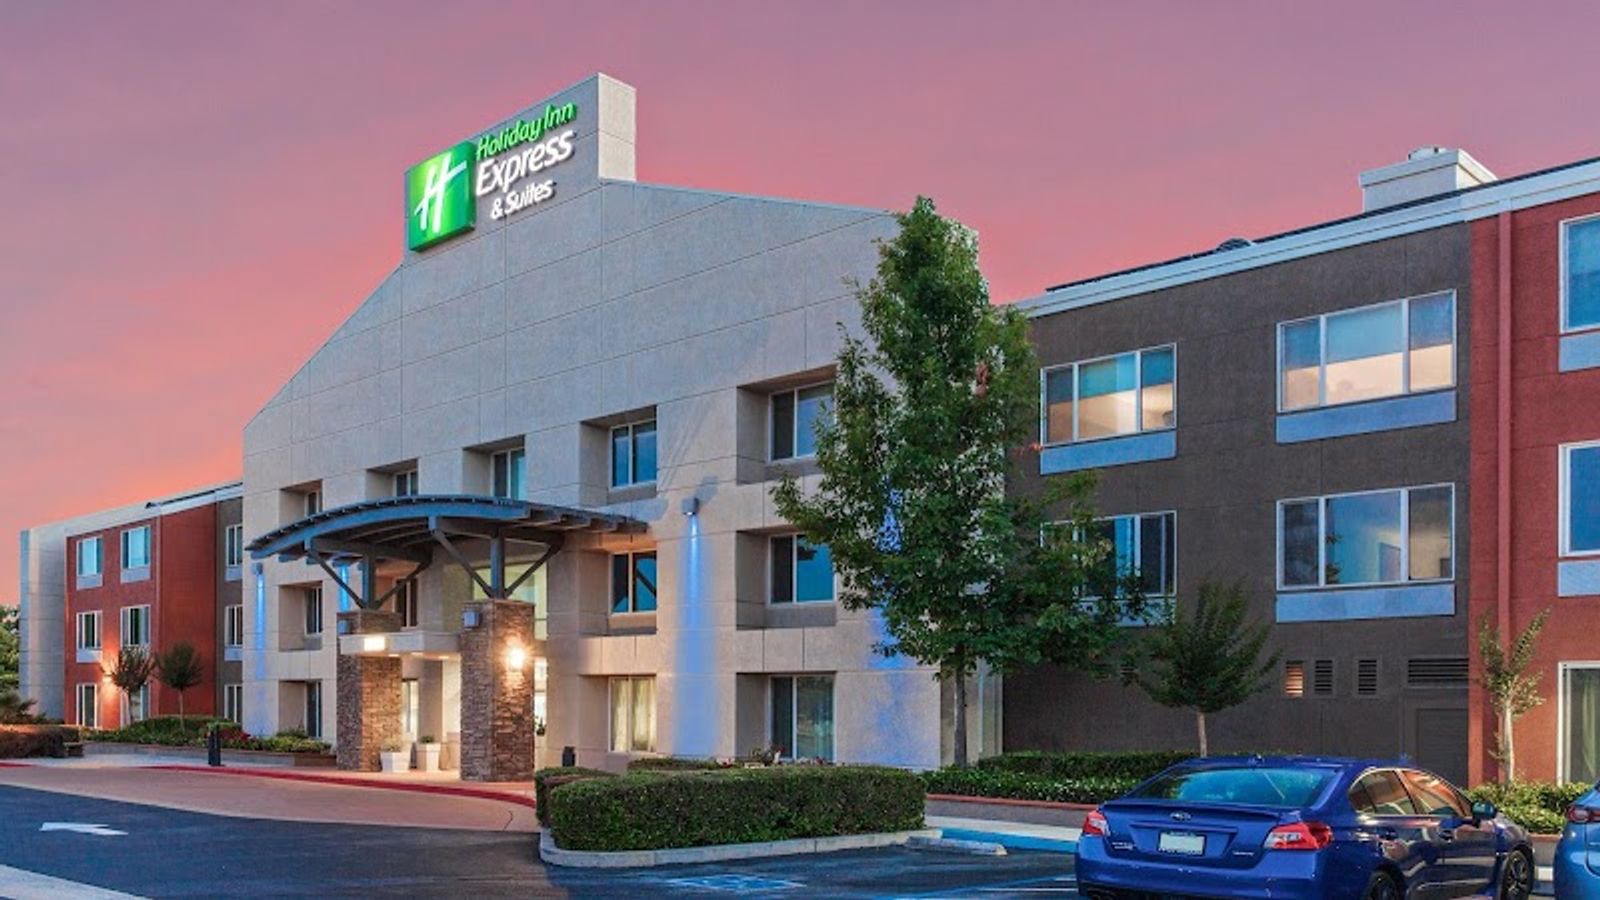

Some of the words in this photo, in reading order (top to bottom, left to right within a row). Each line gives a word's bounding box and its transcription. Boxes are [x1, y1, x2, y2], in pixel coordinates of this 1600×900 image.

[476, 117, 542, 159] Holiday
[544, 101, 575, 130] Inn
[476, 130, 575, 197] Express
[491, 197, 504, 220] &
[505, 180, 555, 214] Suites
